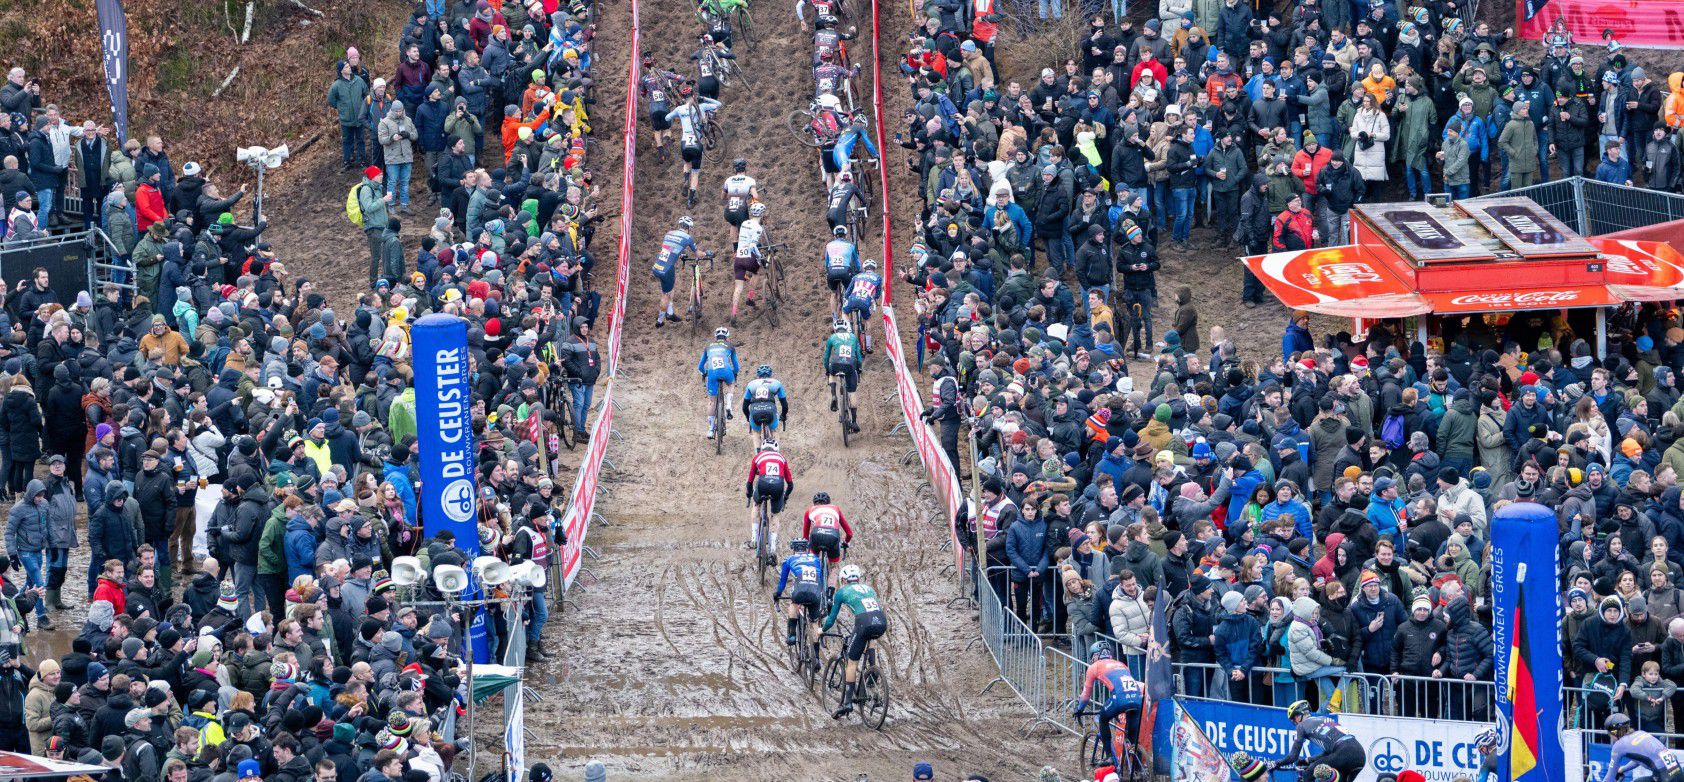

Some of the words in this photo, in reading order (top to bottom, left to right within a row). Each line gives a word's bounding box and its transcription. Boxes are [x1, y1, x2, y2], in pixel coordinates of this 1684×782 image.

[654, 92, 664, 100] 58
[1403, 220, 1446, 240] DRINKS
[739, 248, 749, 256] 50
[840, 347, 851, 356] 36
[712, 359, 723, 367] 55
[436, 347, 463, 443] CEUSTER
[462, 396, 472, 475] BOUWKRANEN
[441, 450, 465, 478] DE
[767, 465, 779, 473] 74
[823, 516, 833, 525] 71
[1495, 547, 1504, 591] GRUES
[802, 570, 816, 578] 46
[866, 601, 878, 609] 35
[1494, 609, 1506, 704] BOUWKRANEN
[1122, 680, 1136, 688] 72
[1206, 721, 1227, 748] DE
[1415, 740, 1444, 767] DE
